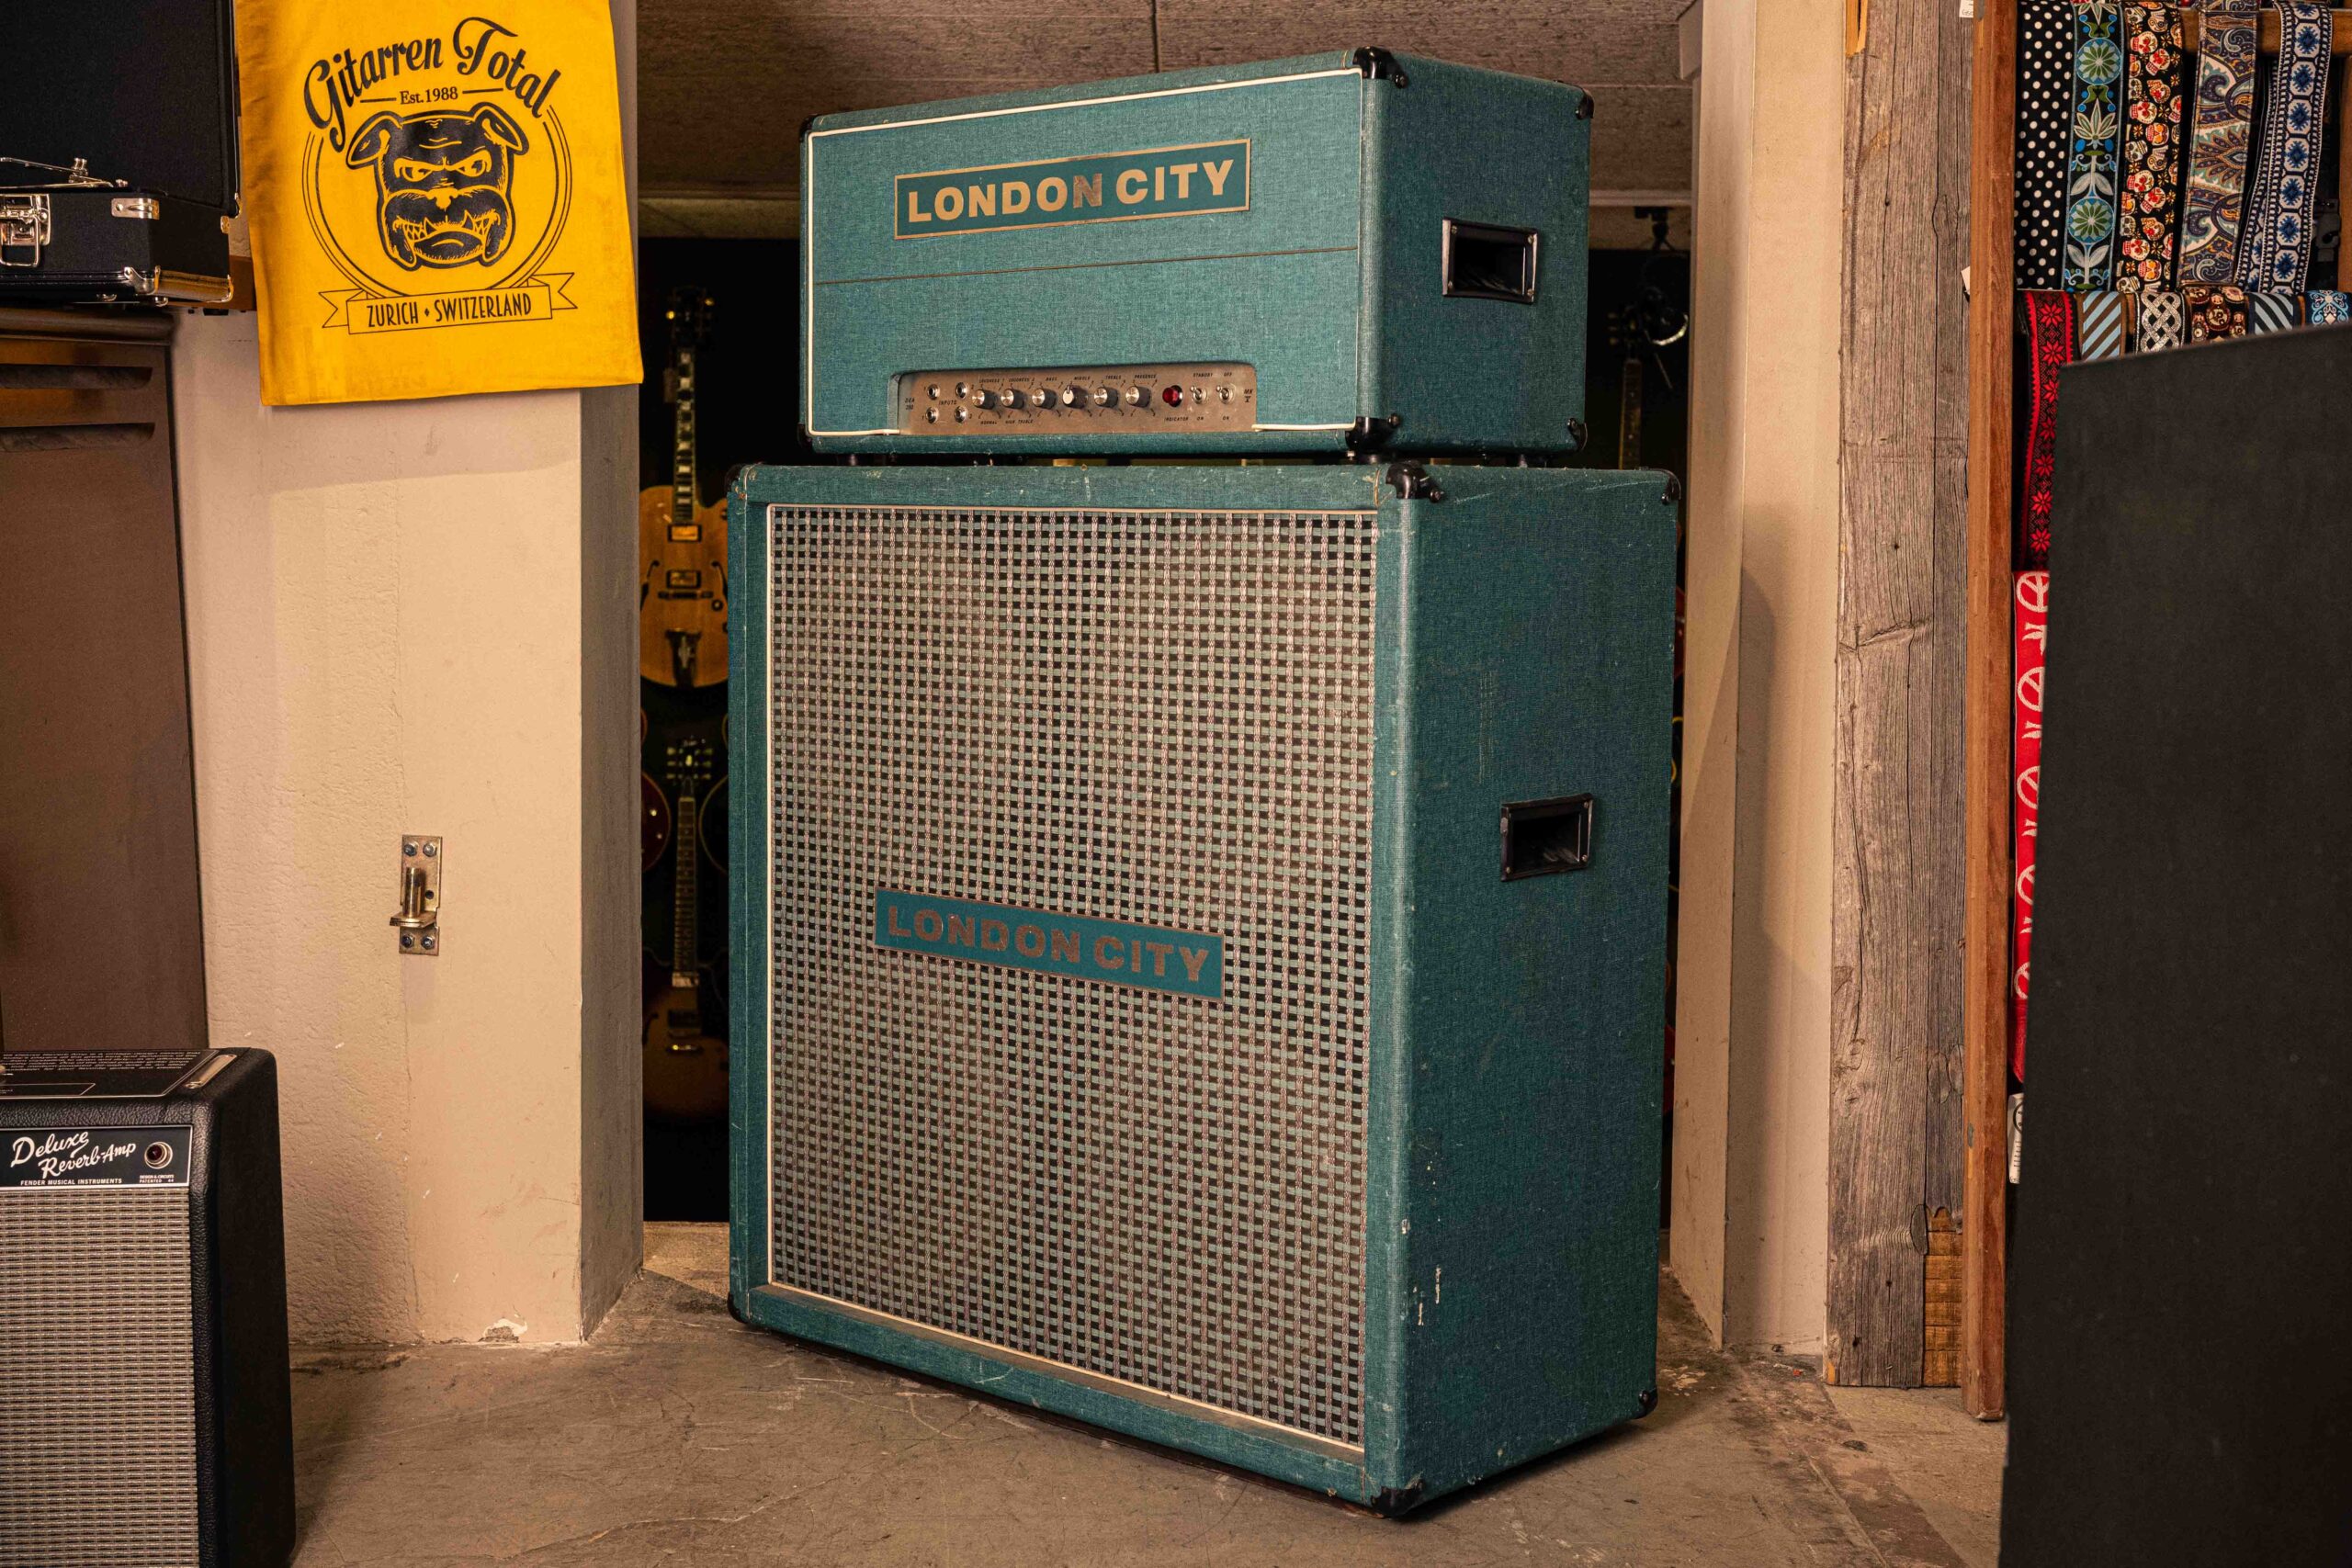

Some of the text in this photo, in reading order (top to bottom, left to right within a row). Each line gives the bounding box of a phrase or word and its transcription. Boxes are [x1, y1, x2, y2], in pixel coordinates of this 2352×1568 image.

[303, 17, 561, 152] Gitarren Total
[909, 159, 1234, 222] LONDON CITY
[367, 292, 531, 327] ZURICH SWITZERLAND
[888, 906, 1208, 982] LONDON CITY
[10, 1131, 89, 1168] Deluxe
[38, 1143, 137, 1179] Reverb-Amp
